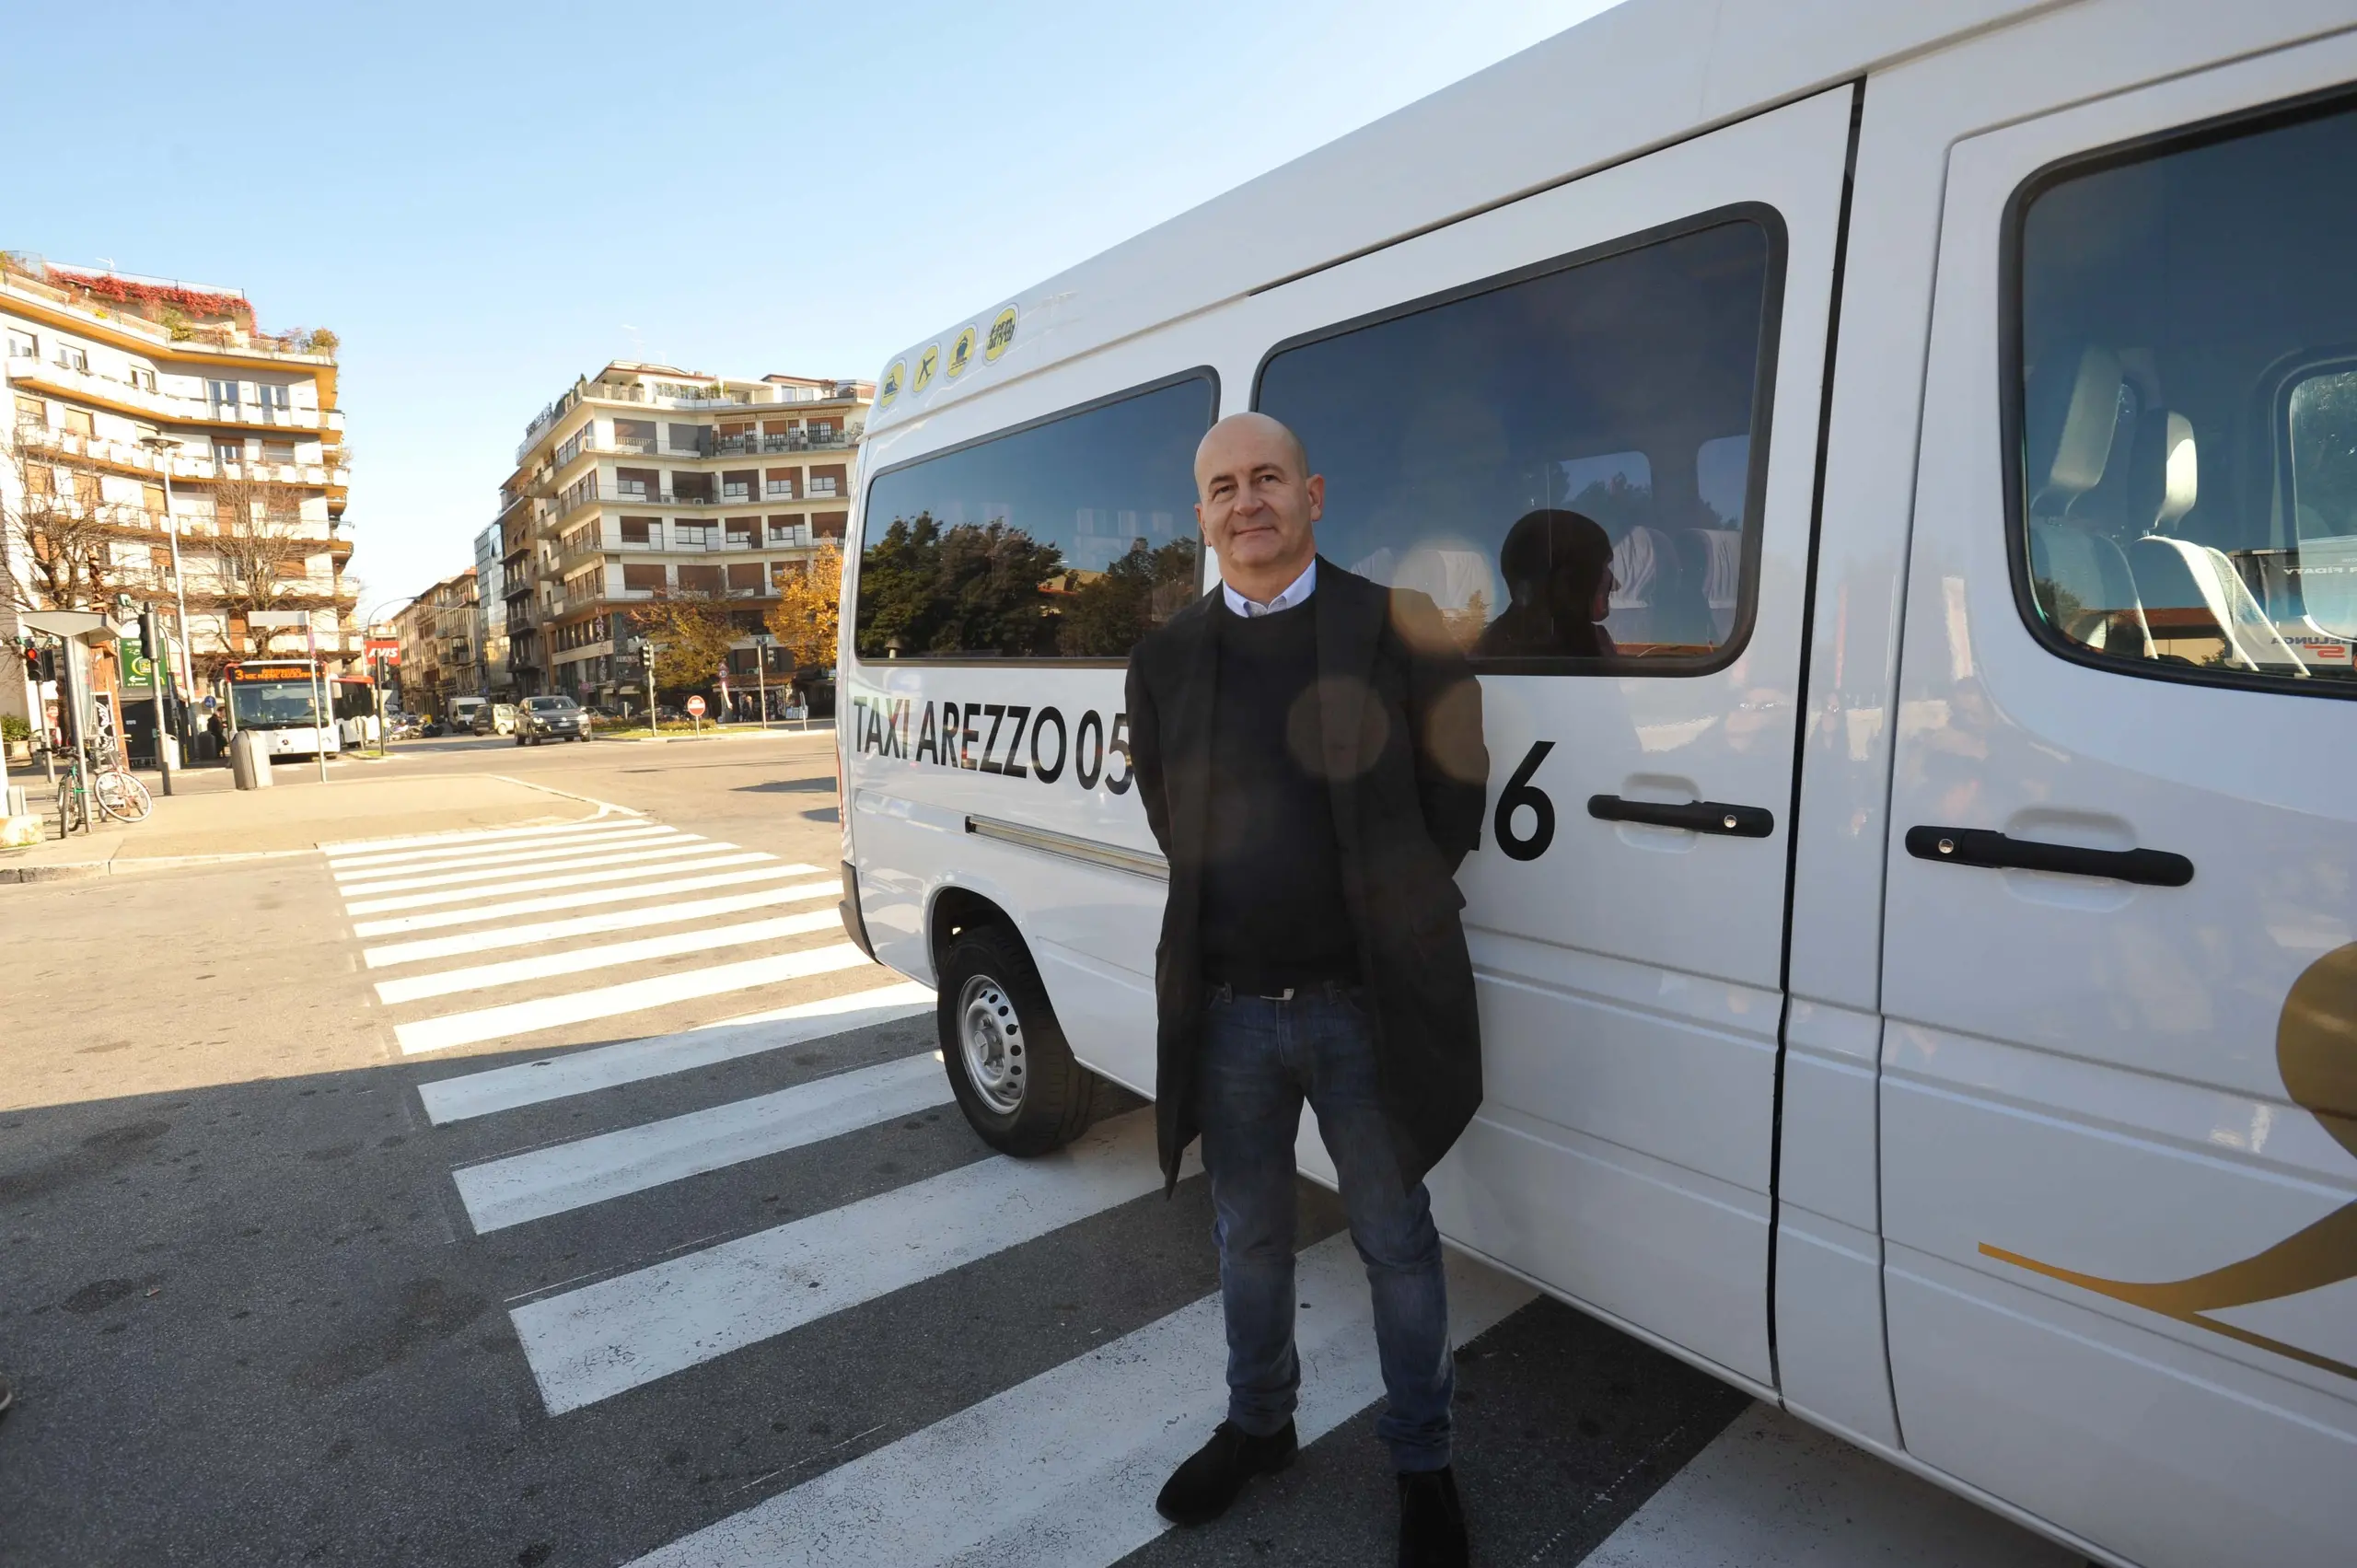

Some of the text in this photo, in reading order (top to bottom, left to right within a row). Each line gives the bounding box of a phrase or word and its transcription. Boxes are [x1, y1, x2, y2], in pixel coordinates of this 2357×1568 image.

[235, 669, 244, 679] 3
[368, 648, 398, 657] AVIS
[853, 696, 1135, 796] TAXI AREZZO 05
[1471, 740, 1556, 862] 6
